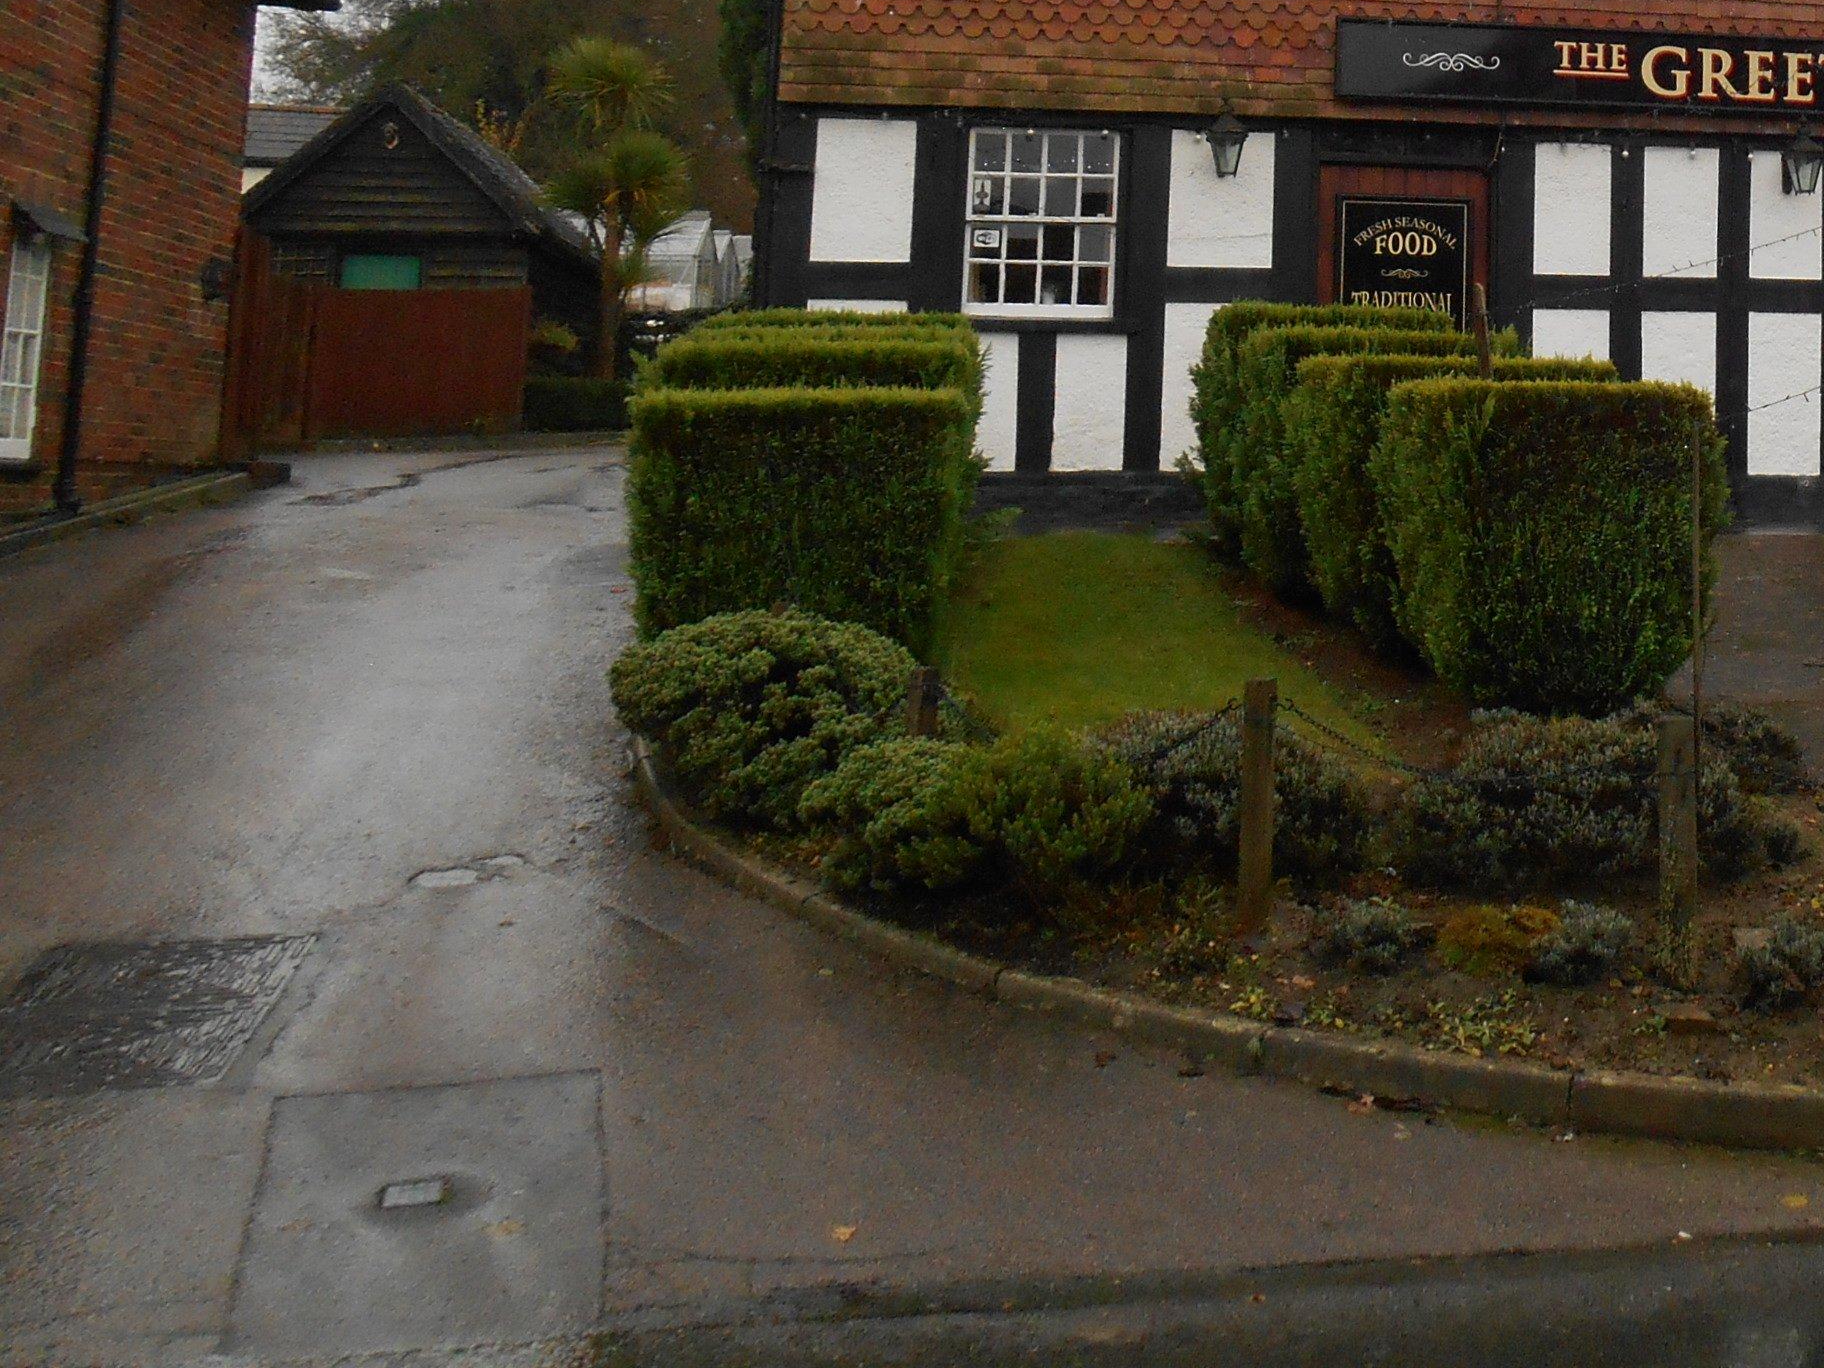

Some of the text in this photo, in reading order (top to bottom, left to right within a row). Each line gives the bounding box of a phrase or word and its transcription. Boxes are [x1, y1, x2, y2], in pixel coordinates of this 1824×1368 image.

[1554, 41, 1628, 71] THE
[1353, 216, 1459, 250] FRESH SEASONAL
[1374, 231, 1438, 256] FOOD
